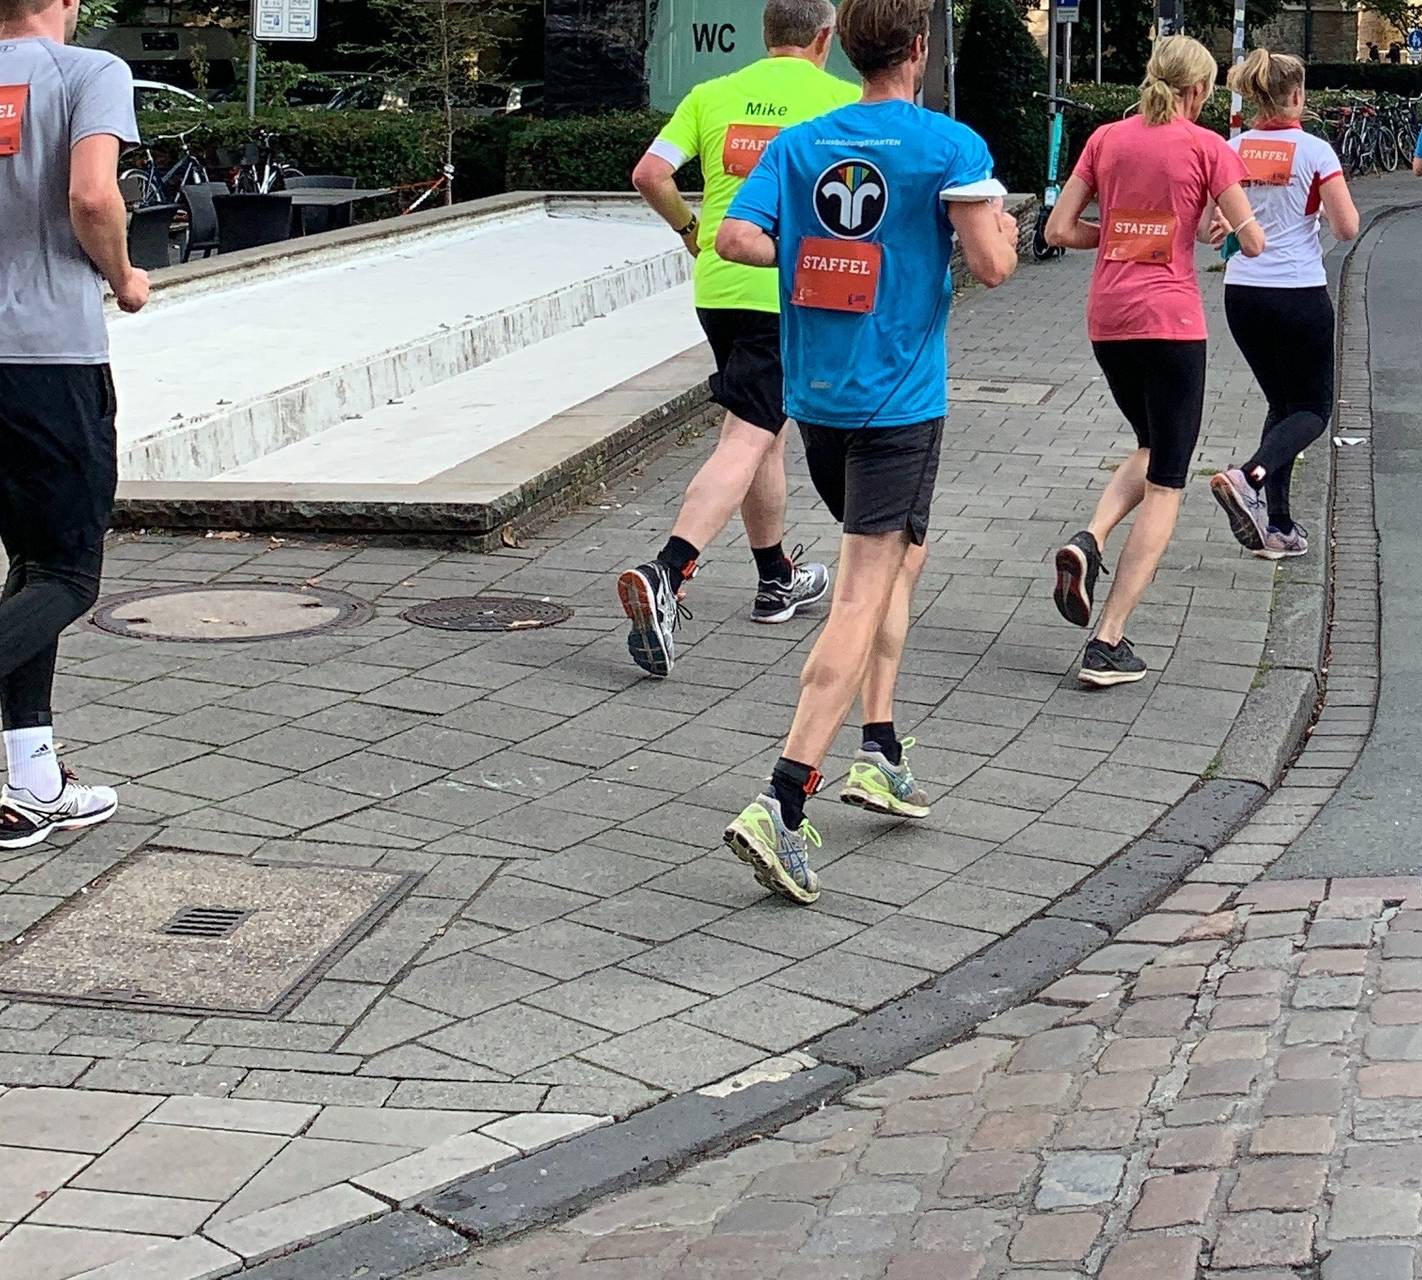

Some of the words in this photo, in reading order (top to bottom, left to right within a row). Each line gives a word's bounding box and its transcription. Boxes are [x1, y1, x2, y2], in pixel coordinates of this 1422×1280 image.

[692, 23, 736, 53] WC
[745, 102, 788, 116] Mike
[731, 138, 769, 151] STAF
[1241, 149, 1289, 161] STAFFEL
[1114, 222, 1169, 235] STAFFEL
[802, 255, 871, 275] STAFFEL
